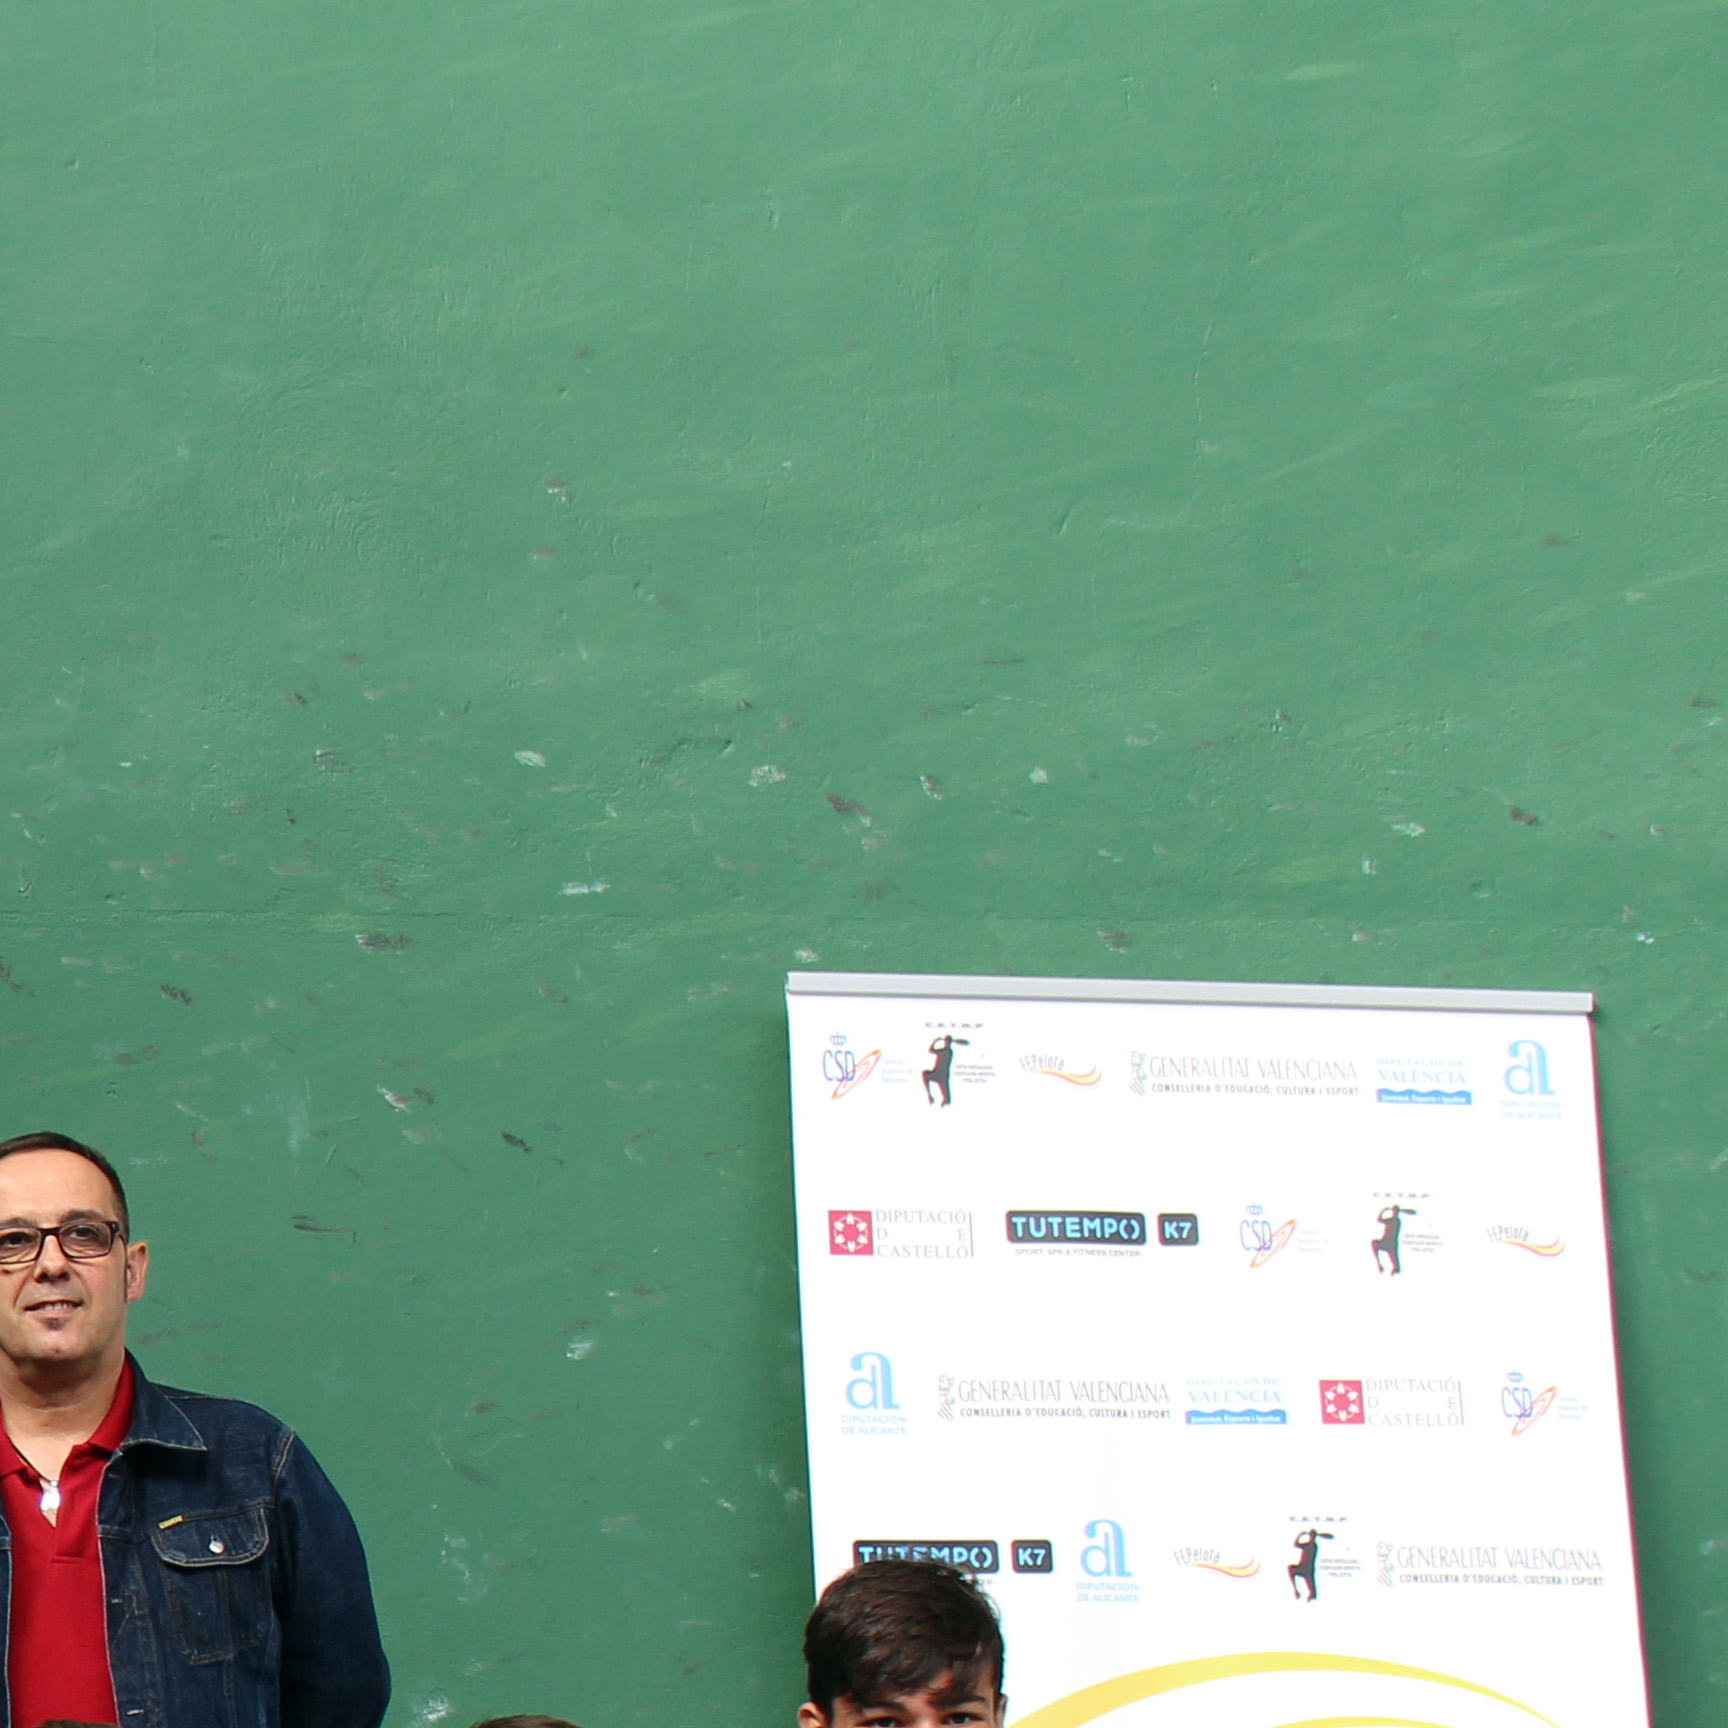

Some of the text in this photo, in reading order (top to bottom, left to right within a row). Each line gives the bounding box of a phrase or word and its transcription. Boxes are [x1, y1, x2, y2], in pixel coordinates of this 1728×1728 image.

[1149, 1056, 1358, 1082] GENERALITAT VALENCIANA
[1011, 1216, 1192, 1240] TUTEMPO K7
[958, 1380, 1170, 1403] GENERALITAT VALENCIANA
[1018, 1547, 1046, 1567] K7
[1397, 1546, 1602, 1571] GENERALITAT VALENCIANA
